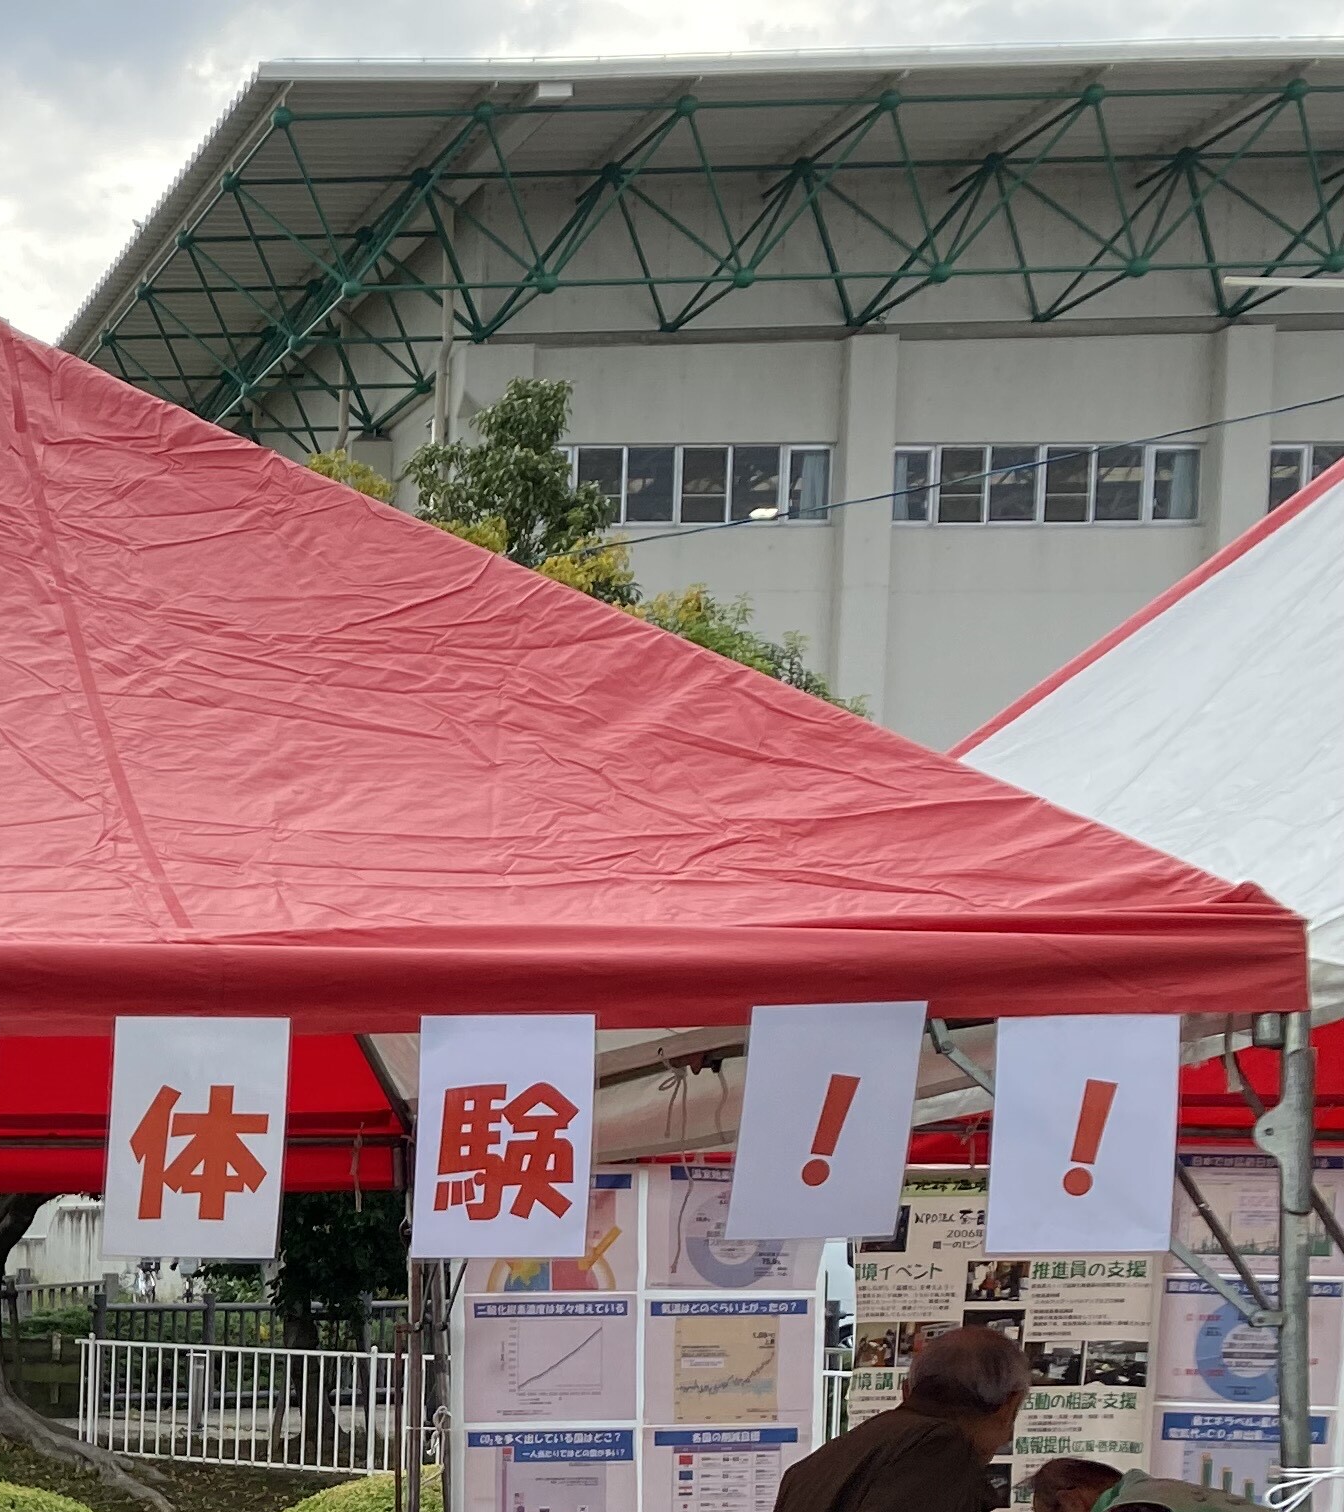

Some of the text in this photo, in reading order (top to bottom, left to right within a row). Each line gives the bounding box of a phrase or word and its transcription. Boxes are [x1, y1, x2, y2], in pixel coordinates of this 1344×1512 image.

[1032, 1260, 1147, 1279] 推進員の支援
